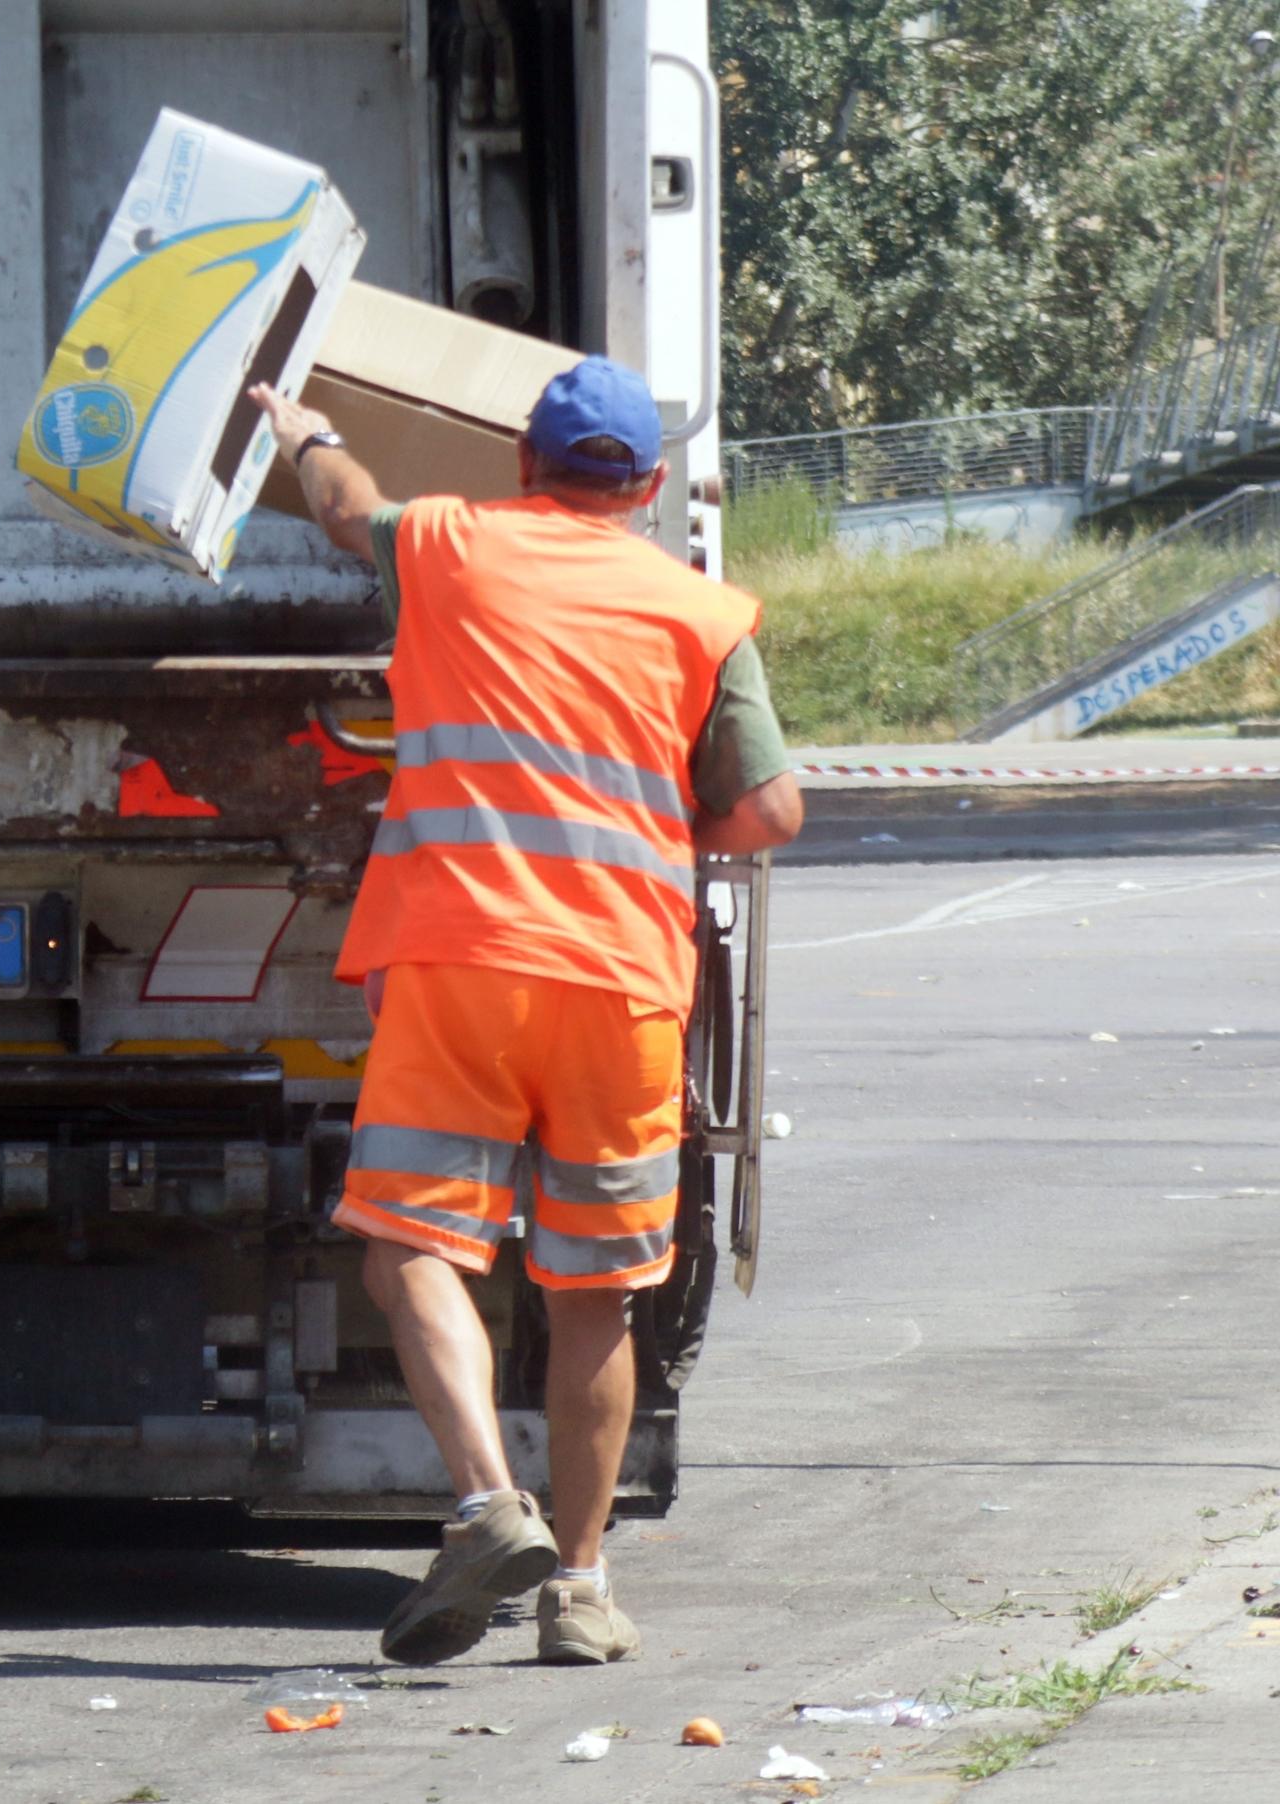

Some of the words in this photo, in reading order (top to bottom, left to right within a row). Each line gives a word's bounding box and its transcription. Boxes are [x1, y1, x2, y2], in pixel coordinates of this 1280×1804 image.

[175, 139, 195, 167] Just
[52, 390, 81, 465] Chiquita
[1076, 609, 1246, 725] DESPERADOS
